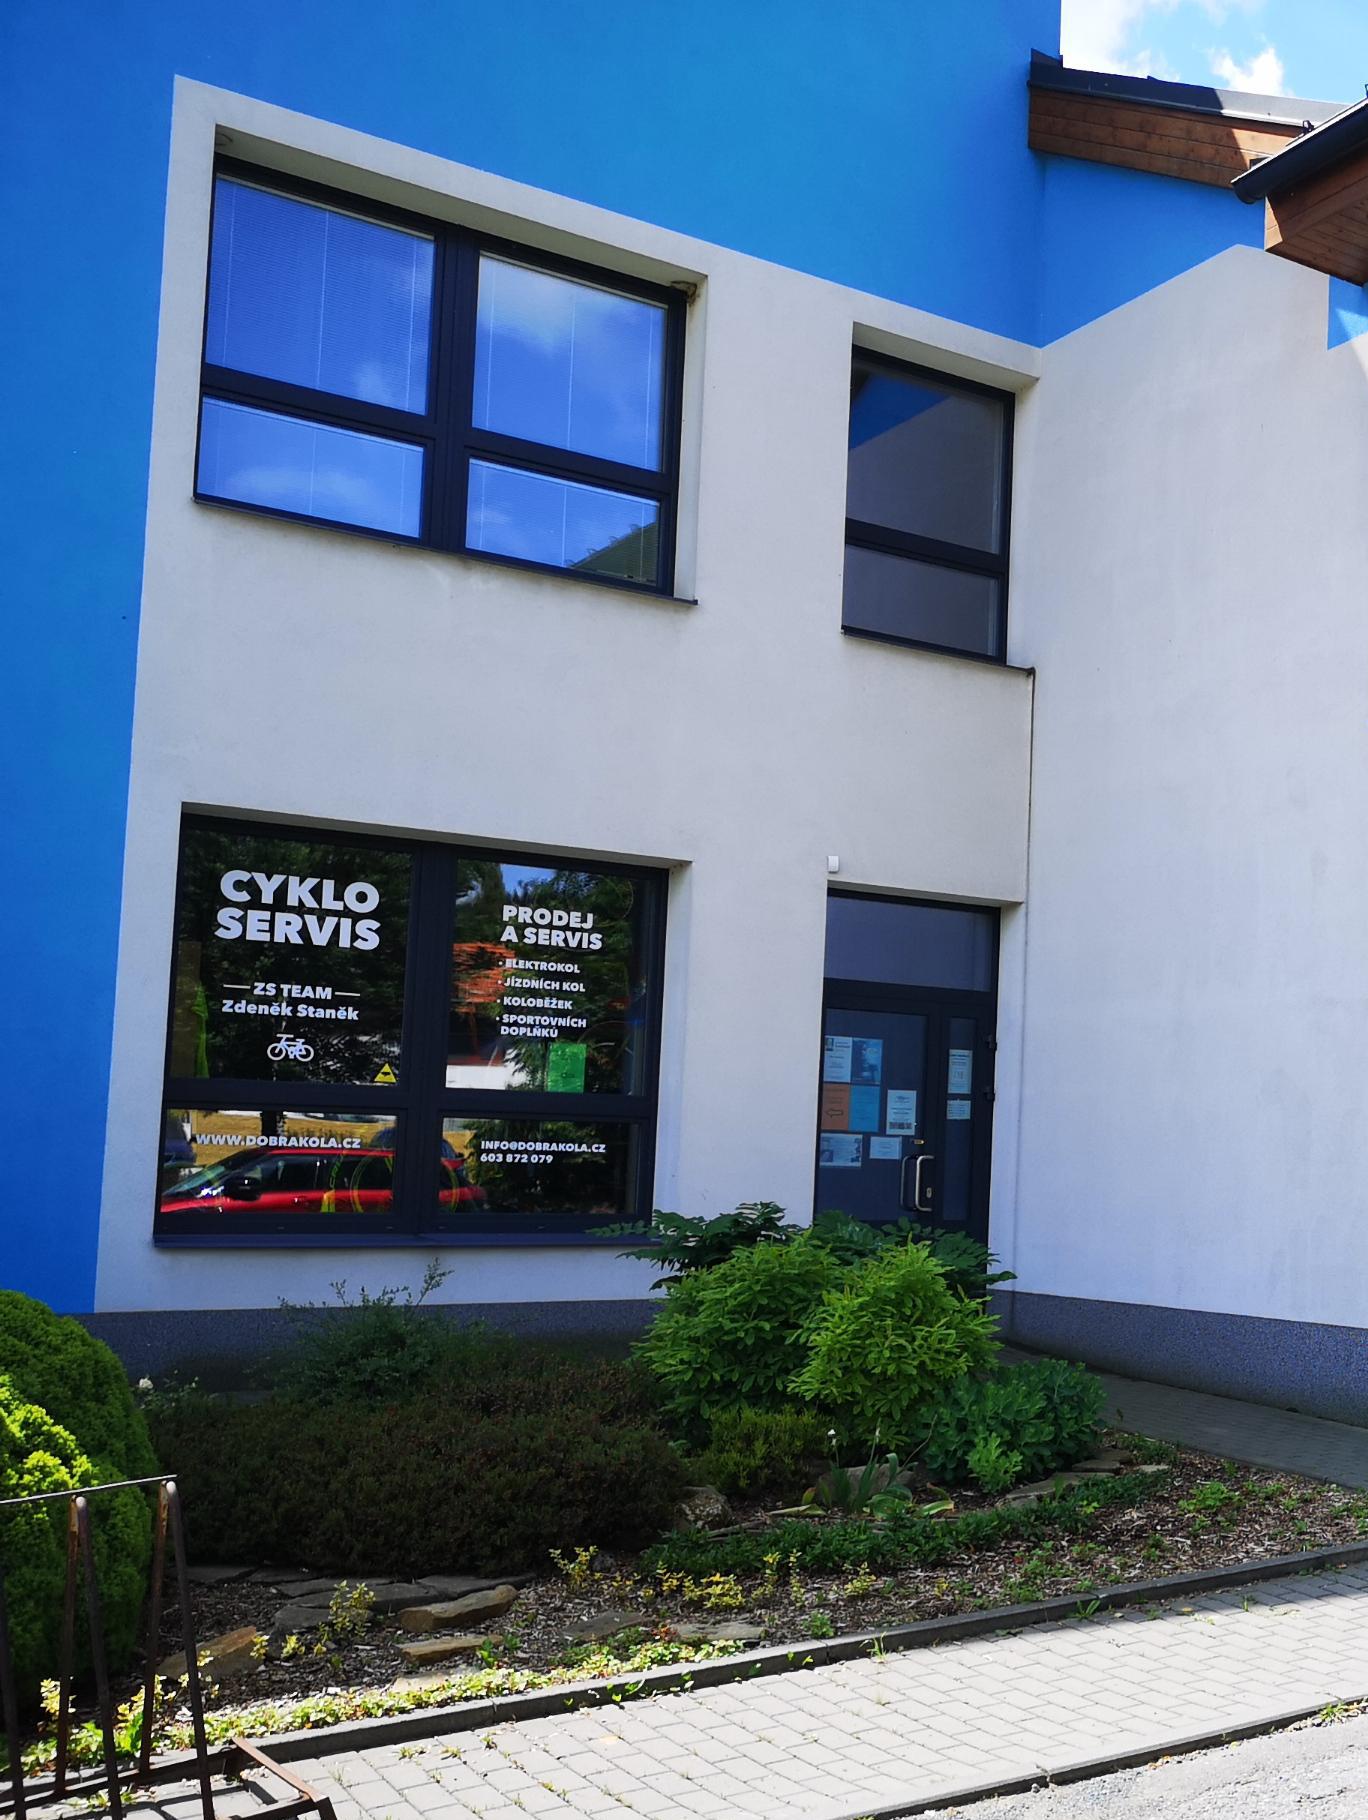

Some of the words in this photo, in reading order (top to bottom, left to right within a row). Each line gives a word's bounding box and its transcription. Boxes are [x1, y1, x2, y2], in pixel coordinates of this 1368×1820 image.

[220, 869, 380, 914] CYKLO
[502, 904, 594, 930] PRODEJ
[214, 906, 382, 951] SERVIS
[500, 925, 519, 943] A
[523, 926, 603, 950] SERVIS
[505, 958, 581, 974] ELEKTROKOL
[253, 981, 277, 997] ZS
[280, 983, 333, 1000] TEAM
[503, 975, 560, 991] JÍZDNÍCH
[562, 981, 586, 993] KOL
[222, 999, 293, 1017] Zdeněk
[296, 1004, 359, 1021] Staněk
[503, 996, 573, 1010] KOLOBĚŽEK
[502, 1013, 587, 1028] SPORTOVNÍCH
[196, 1133, 361, 1149] WWW.DOBRAKOLA.CZ
[480, 1140, 606, 1153] INFO@DOBRAKOLA.CZ
[480, 1153, 503, 1163] 603
[505, 1154, 529, 1163] 872
[530, 1155, 554, 1164] 079
